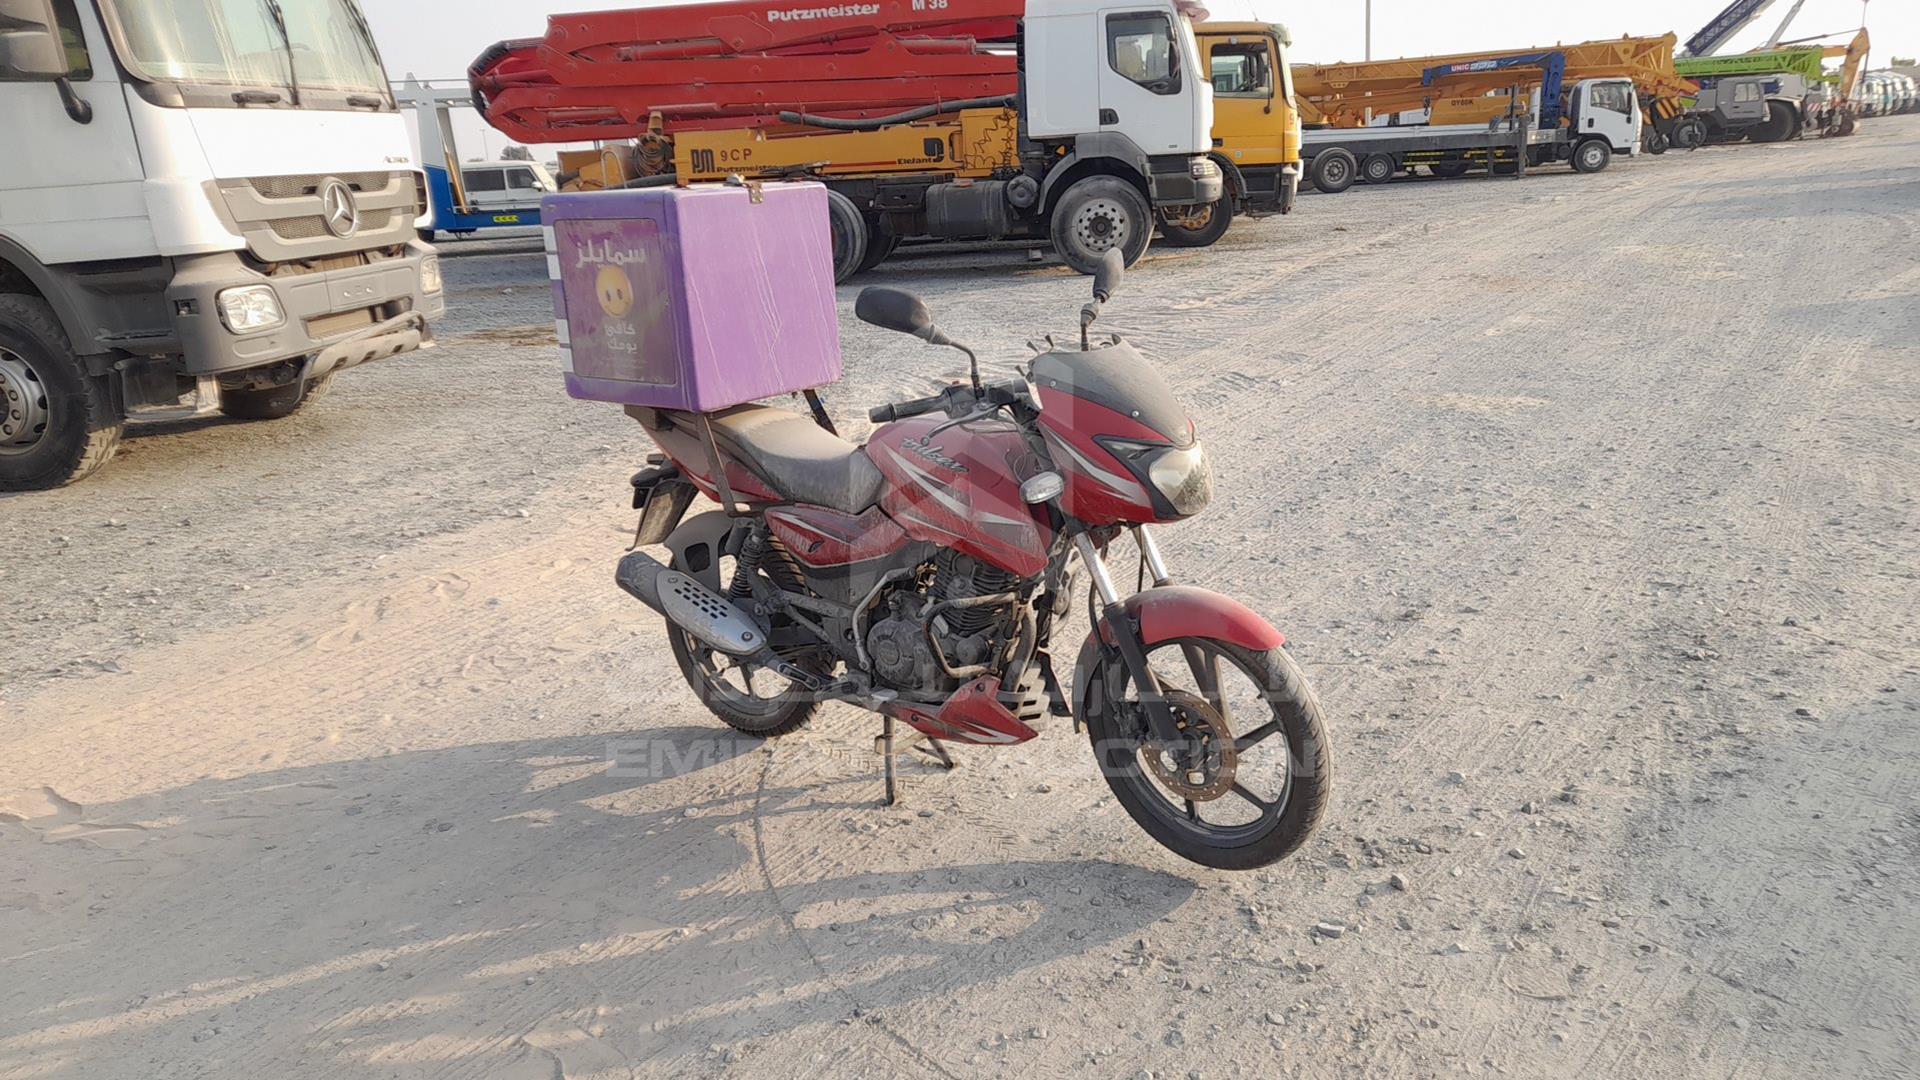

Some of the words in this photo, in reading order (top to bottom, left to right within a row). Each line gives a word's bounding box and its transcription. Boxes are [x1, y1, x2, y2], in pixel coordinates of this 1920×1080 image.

[767, 4, 880, 22] Putzmeister
[912, 0, 925, 11] M
[929, 0, 948, 9] 38
[576, 239, 646, 268] سمايلز
